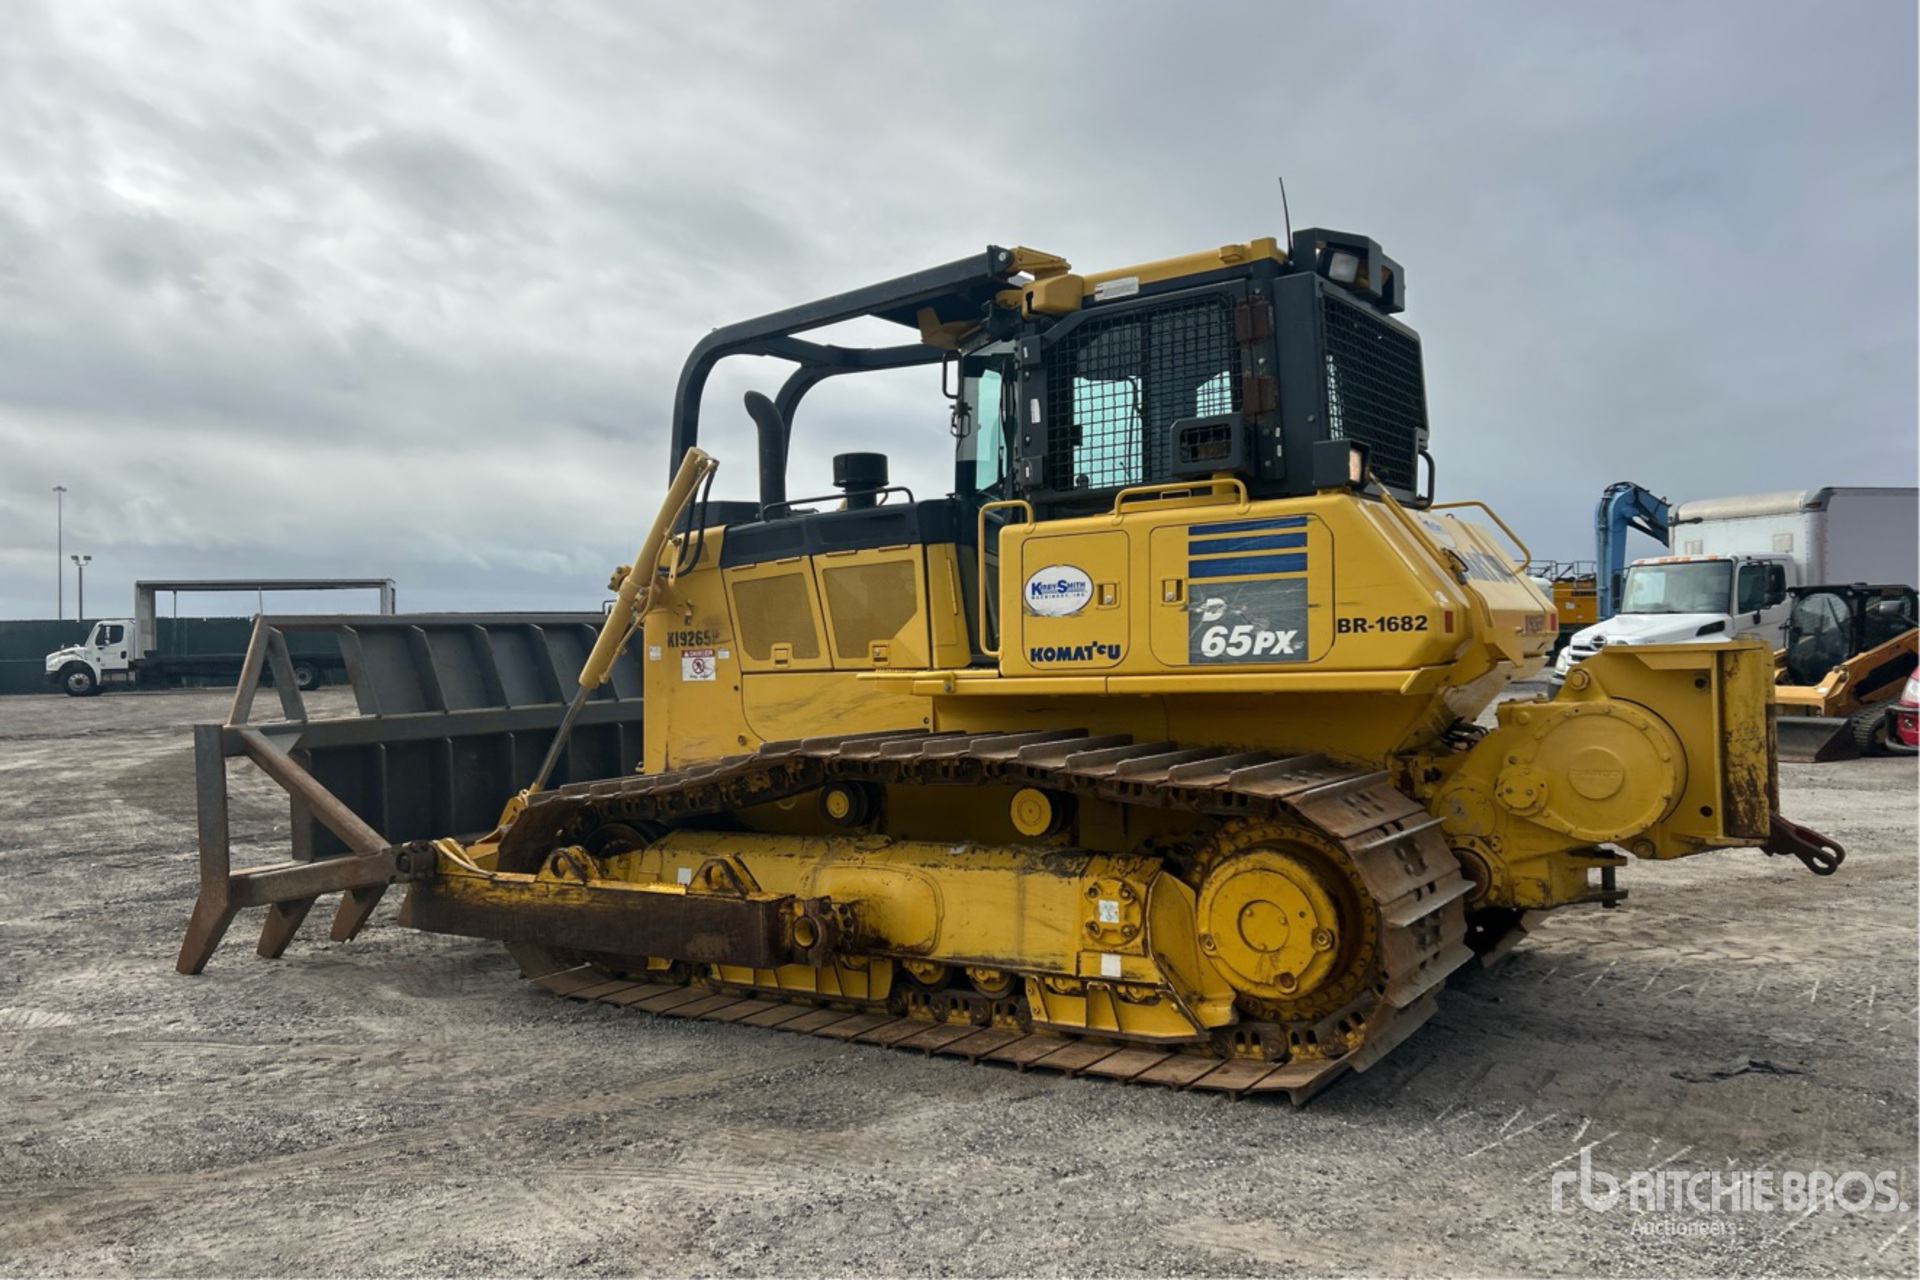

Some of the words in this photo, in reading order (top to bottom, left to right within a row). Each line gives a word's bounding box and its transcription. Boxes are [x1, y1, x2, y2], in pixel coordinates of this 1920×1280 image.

[1337, 614, 1428, 634] BR-1682
[1030, 641, 1121, 662] KOMATSU
[1201, 625, 1298, 658] 65PX
